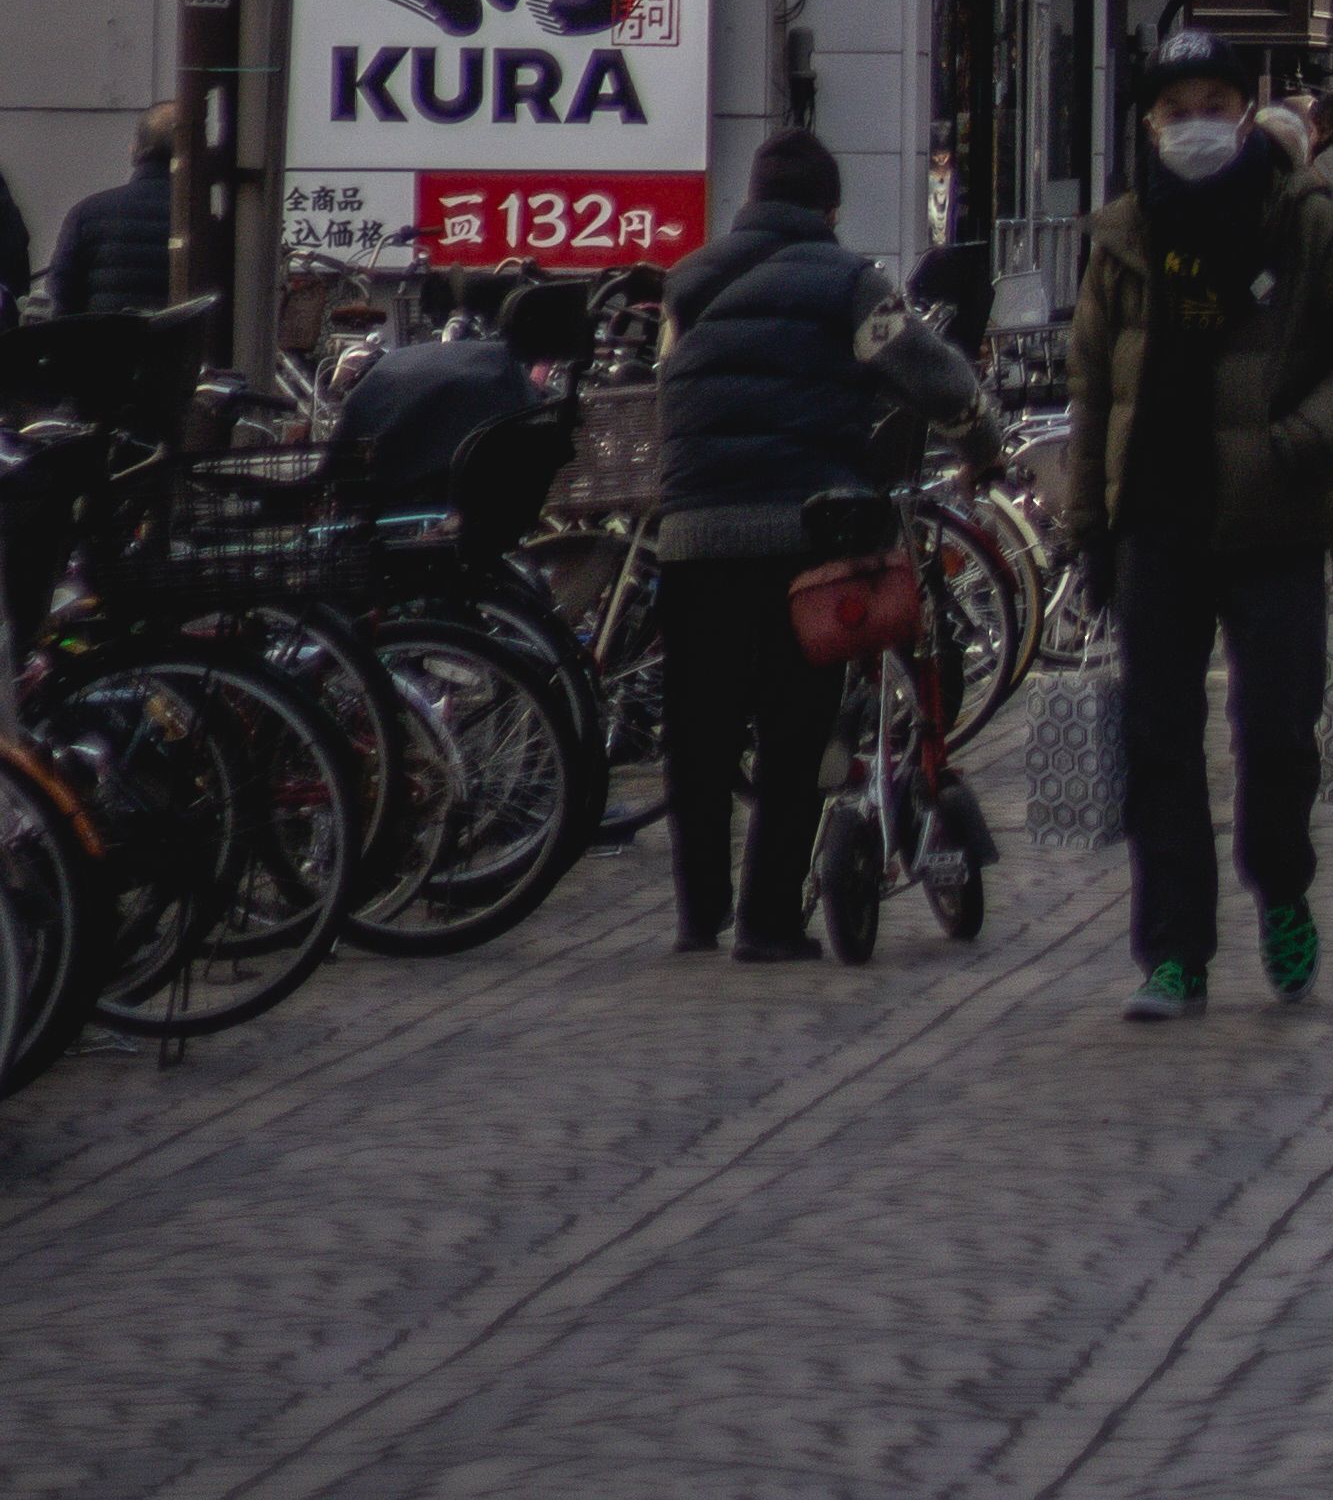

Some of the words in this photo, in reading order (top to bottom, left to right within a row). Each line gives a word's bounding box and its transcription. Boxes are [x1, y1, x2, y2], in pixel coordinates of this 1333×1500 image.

[330, 46, 648, 126] KURA
[285, 186, 364, 213] 全商品
